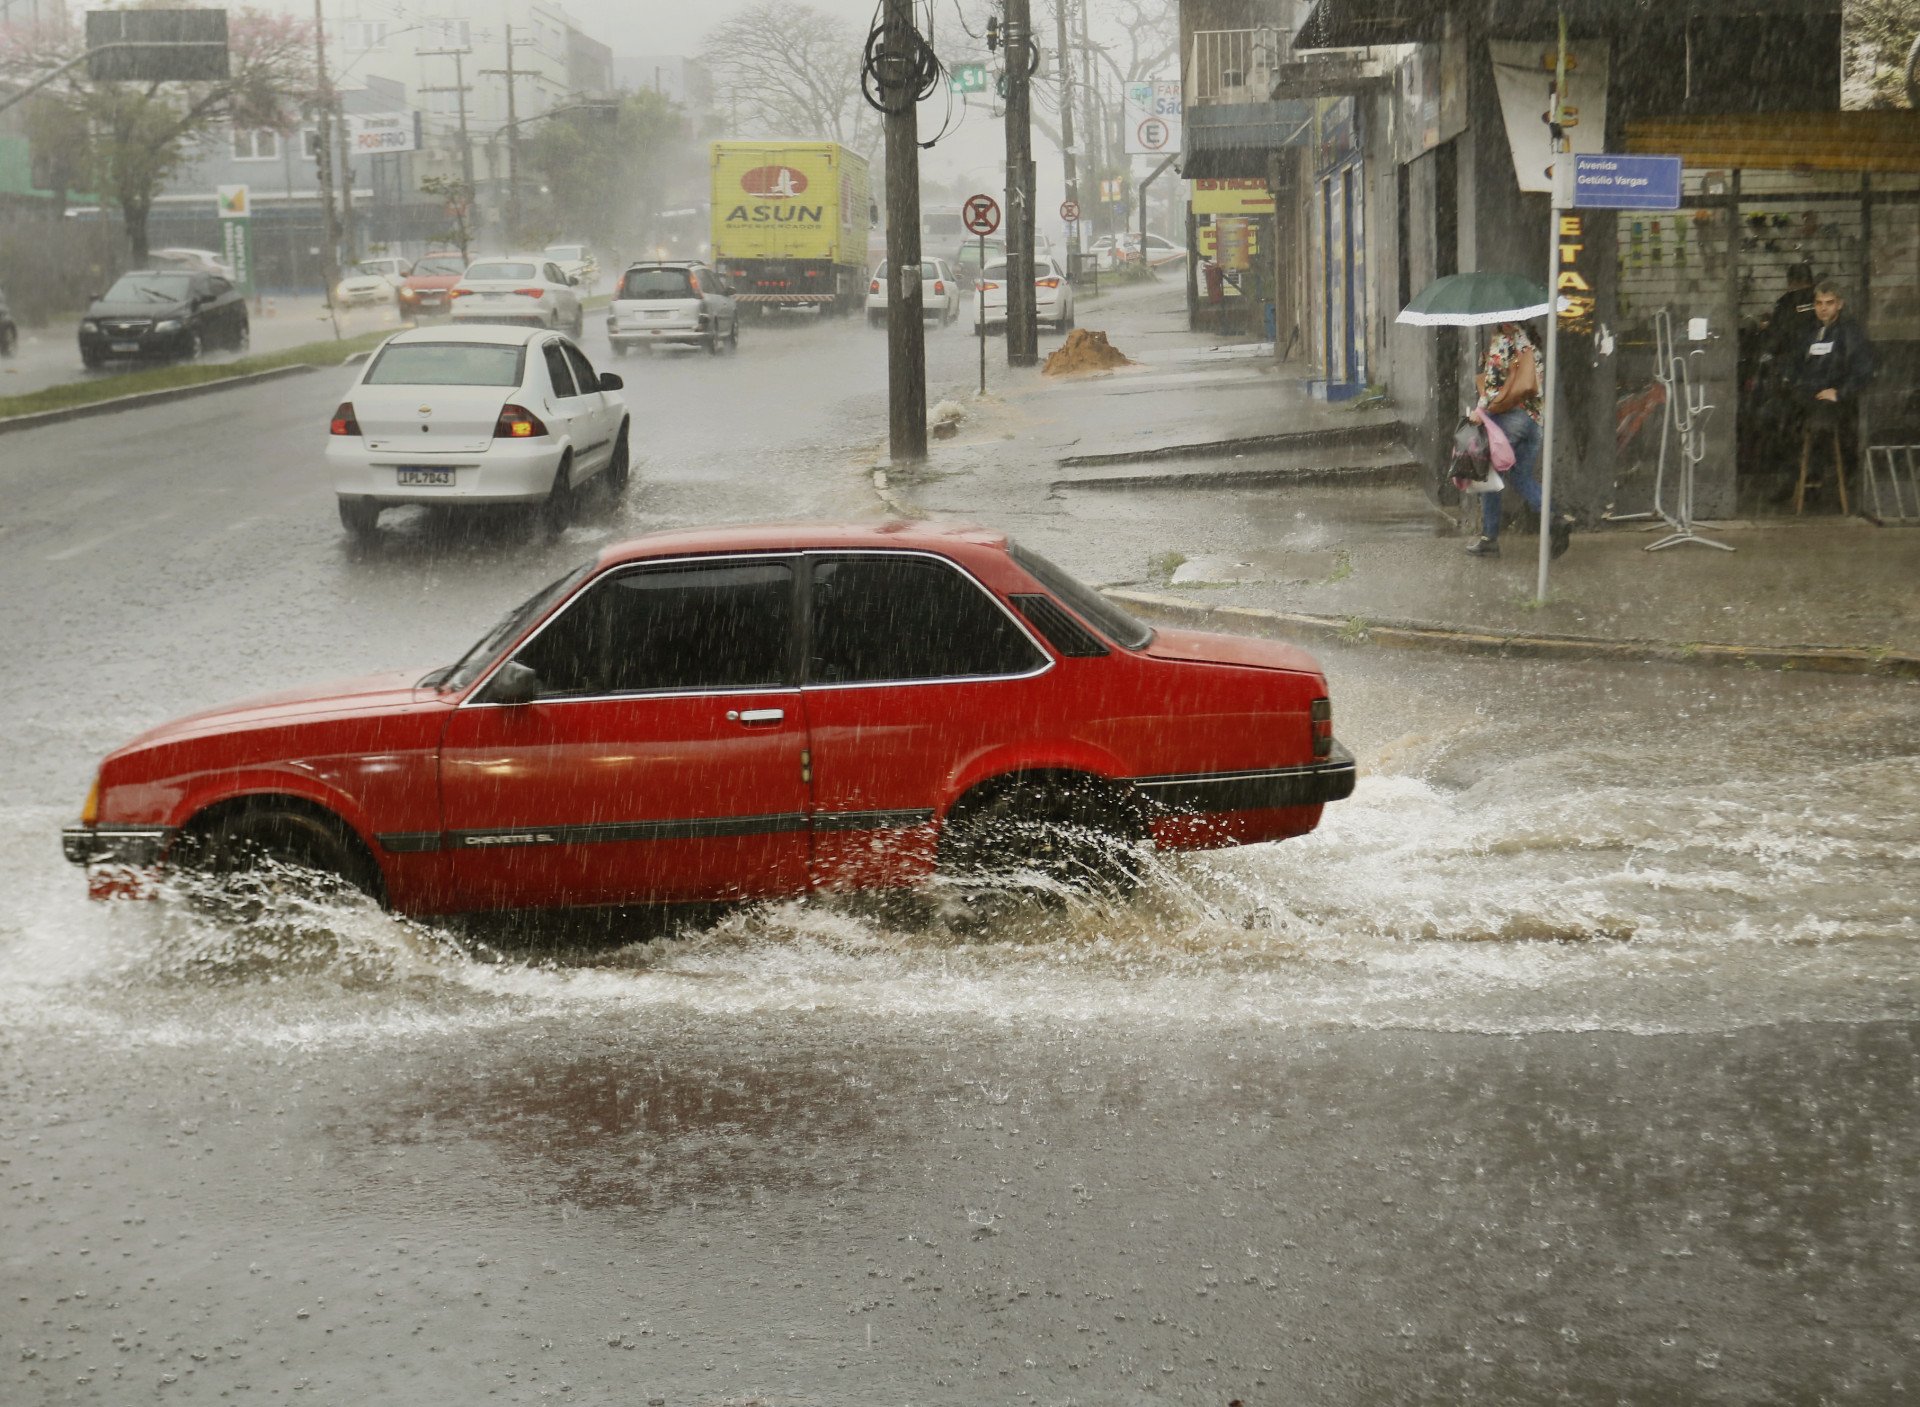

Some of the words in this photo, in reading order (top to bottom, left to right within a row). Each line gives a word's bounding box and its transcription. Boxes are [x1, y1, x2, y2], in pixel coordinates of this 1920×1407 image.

[1146, 125, 1160, 143] E
[1578, 160, 1617, 171] Avenida
[1578, 174, 1613, 185] Getúlio
[1615, 175, 1649, 188] Vargas
[725, 206, 823, 222] ASUN
